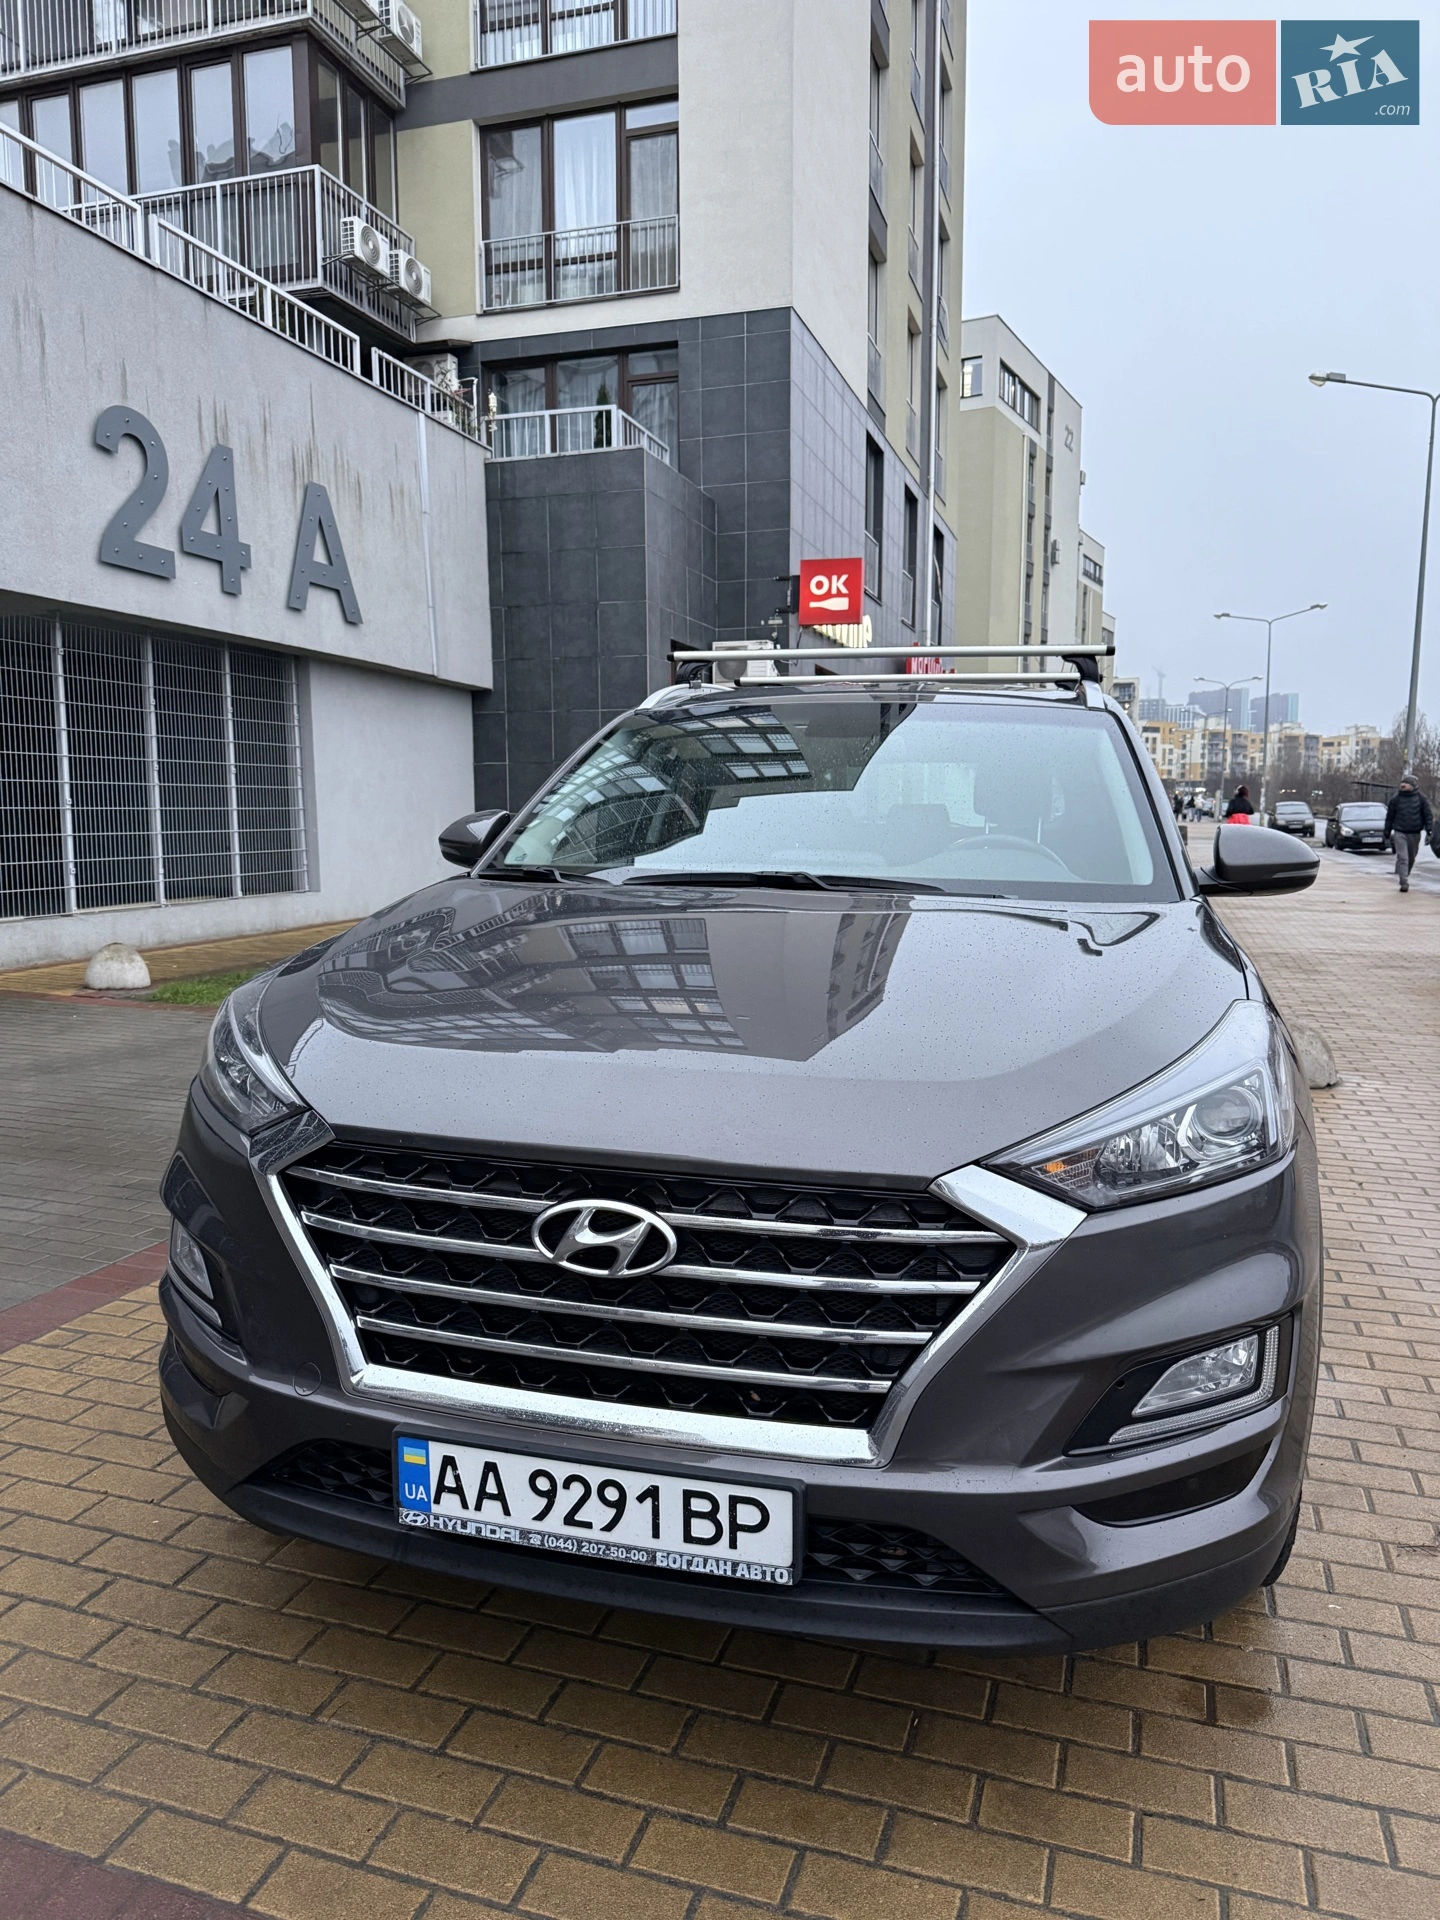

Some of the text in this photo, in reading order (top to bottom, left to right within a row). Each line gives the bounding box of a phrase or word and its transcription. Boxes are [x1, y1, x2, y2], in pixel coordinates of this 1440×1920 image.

[809, 574, 849, 596] OK
[404, 1482, 428, 1502] UA
[433, 1454, 771, 1550] AA 9291 BP
[429, 1515, 648, 1562] HYUNDAI (044) 207-50-00
[655, 1551, 789, 1584] БОГДАН АВТО
